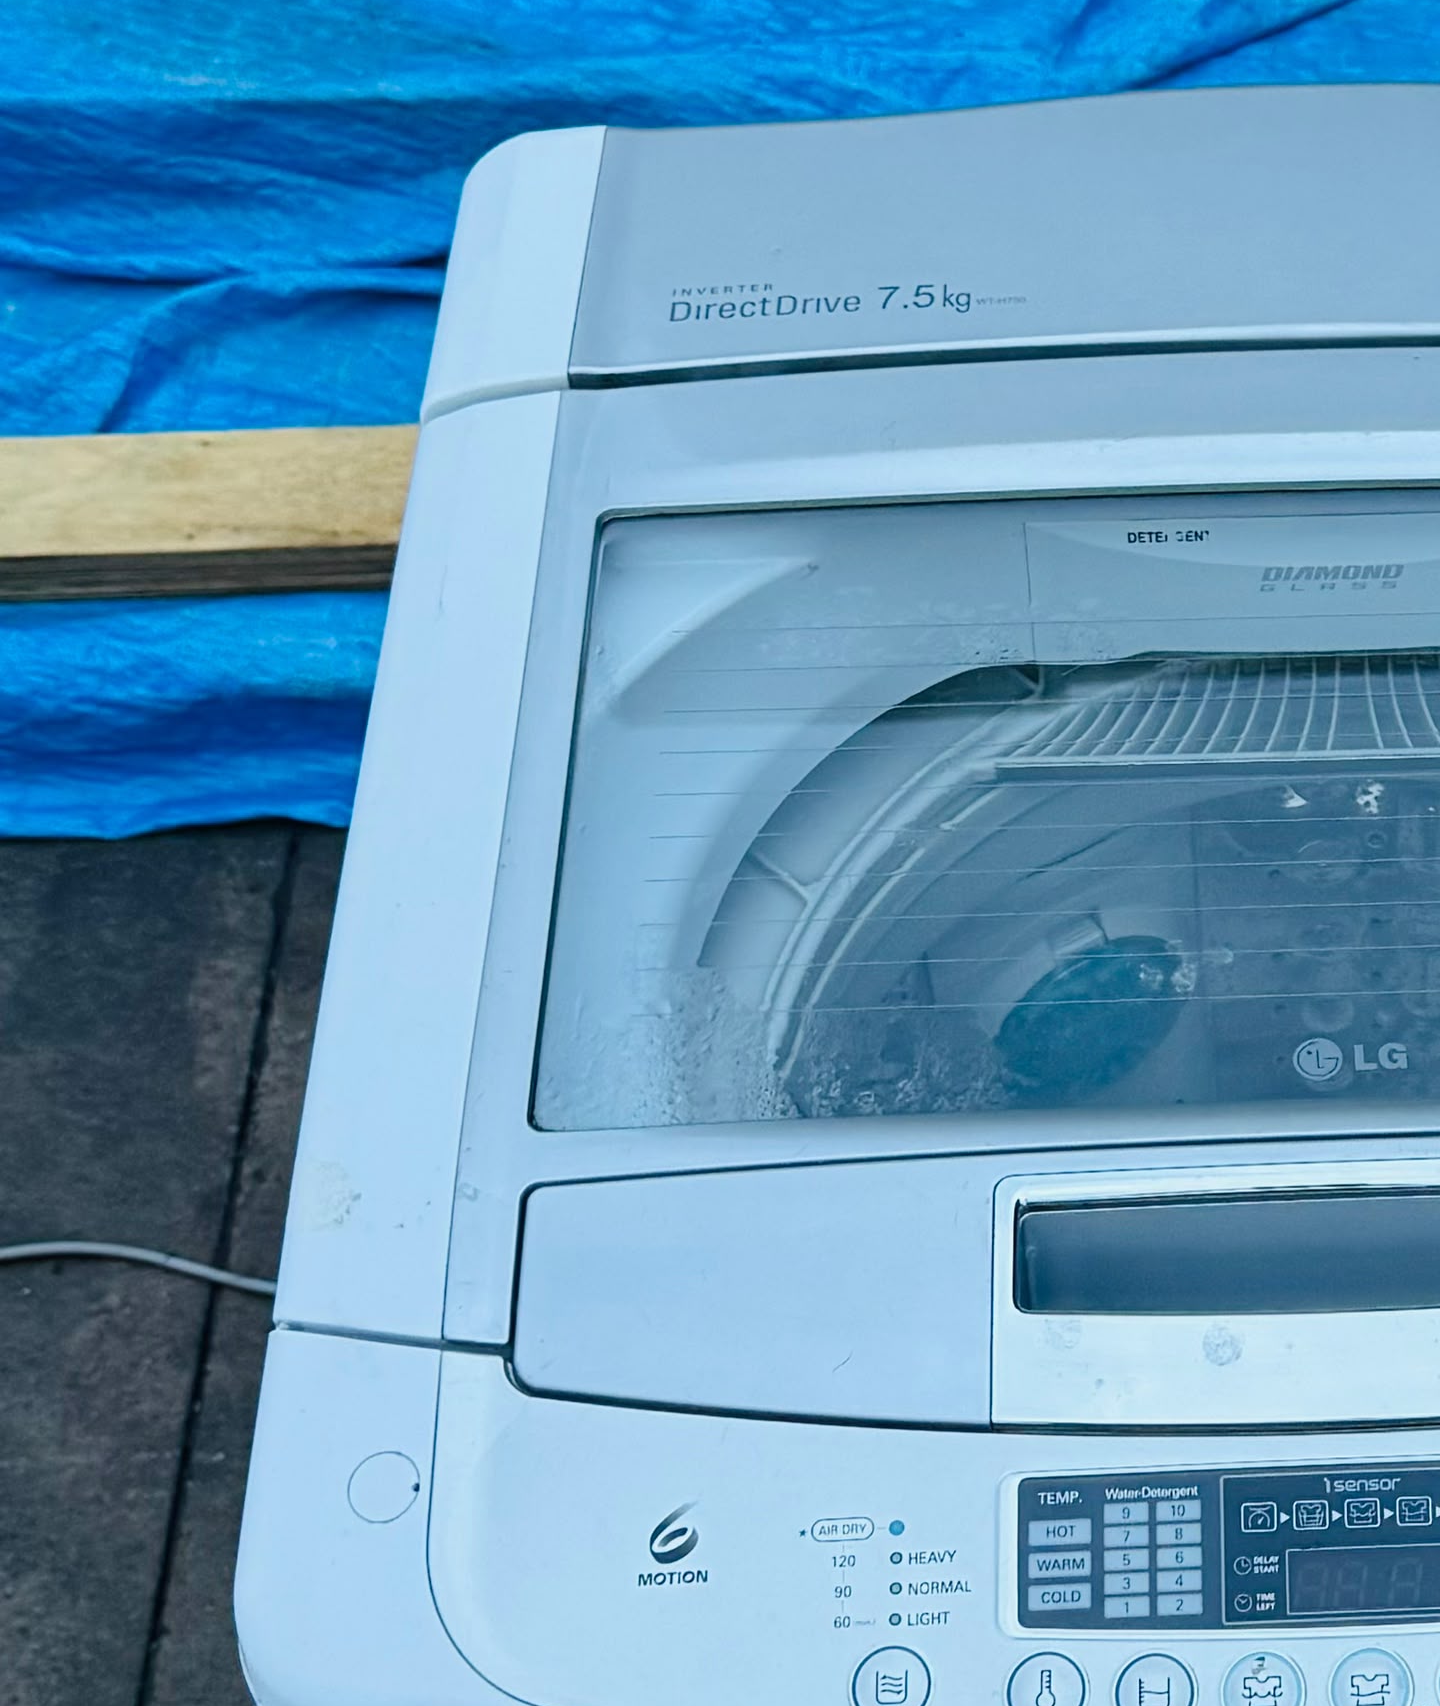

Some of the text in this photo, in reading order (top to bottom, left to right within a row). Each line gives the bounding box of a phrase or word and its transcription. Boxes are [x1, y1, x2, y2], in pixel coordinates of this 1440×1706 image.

[672, 283, 773, 297] INVERTER
[1127, 530, 1210, 544] DETEGEN
[1261, 564, 1405, 582] DIAMOND
[1259, 581, 1398, 592] GLASS
[1353, 1042, 1409, 1072] LG
[1037, 1491, 1083, 1505] TEMP.
[1122, 1506, 1131, 1519] 9
[1170, 1504, 1186, 1518] 10
[818, 1523, 867, 1536] AIR DRY
[1046, 1525, 1076, 1539] HOT
[1174, 1527, 1183, 1540] 8
[1123, 1530, 1131, 1543] 7
[832, 1554, 856, 1568] 120
[908, 1550, 957, 1565] HEAVY
[1122, 1553, 1131, 1566] 5
[1175, 1550, 1184, 1564] 6
[1253, 1555, 1279, 1564] DELAY
[1036, 1558, 1085, 1572] WARM
[1253, 1564, 1279, 1573] START
[637, 1570, 708, 1586] MOTION
[1122, 1577, 1131, 1590] 3
[1174, 1574, 1184, 1587] 4
[834, 1585, 852, 1598] 90
[908, 1580, 972, 1596] NORMAL
[1041, 1590, 1081, 1604] COLD
[1256, 1592, 1276, 1601] TIME
[1124, 1601, 1130, 1614] 1
[1175, 1599, 1184, 1612] 2
[1256, 1601, 1275, 1611] LEFT
[833, 1616, 851, 1629] 60
[907, 1611, 950, 1626] LIGHT
